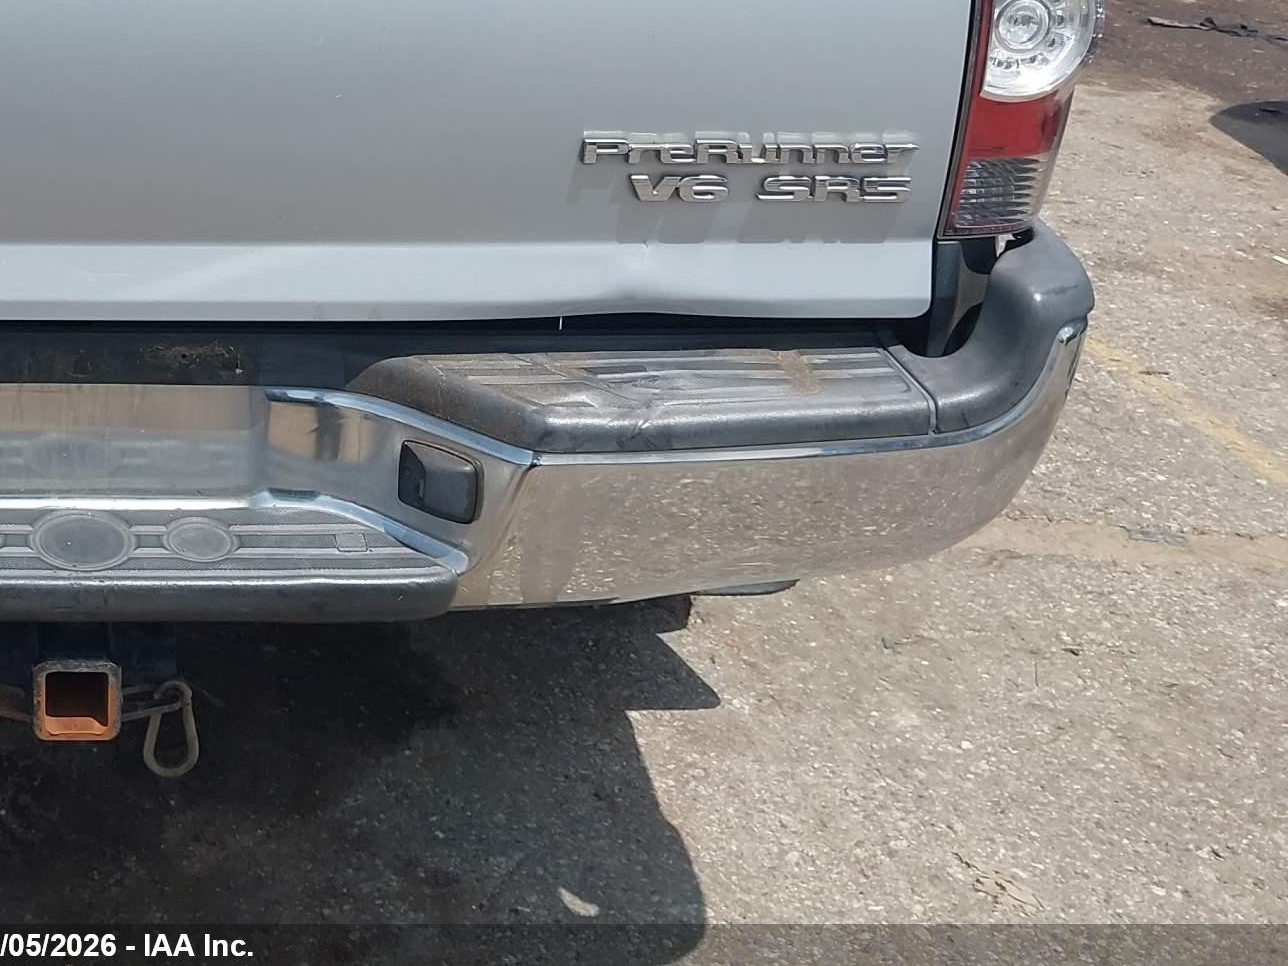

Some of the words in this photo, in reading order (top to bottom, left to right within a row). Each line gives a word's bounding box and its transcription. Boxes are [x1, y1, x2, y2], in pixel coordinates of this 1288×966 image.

[582, 138, 920, 164] PreRunner
[629, 175, 729, 203] V6
[756, 175, 912, 203] SR5
